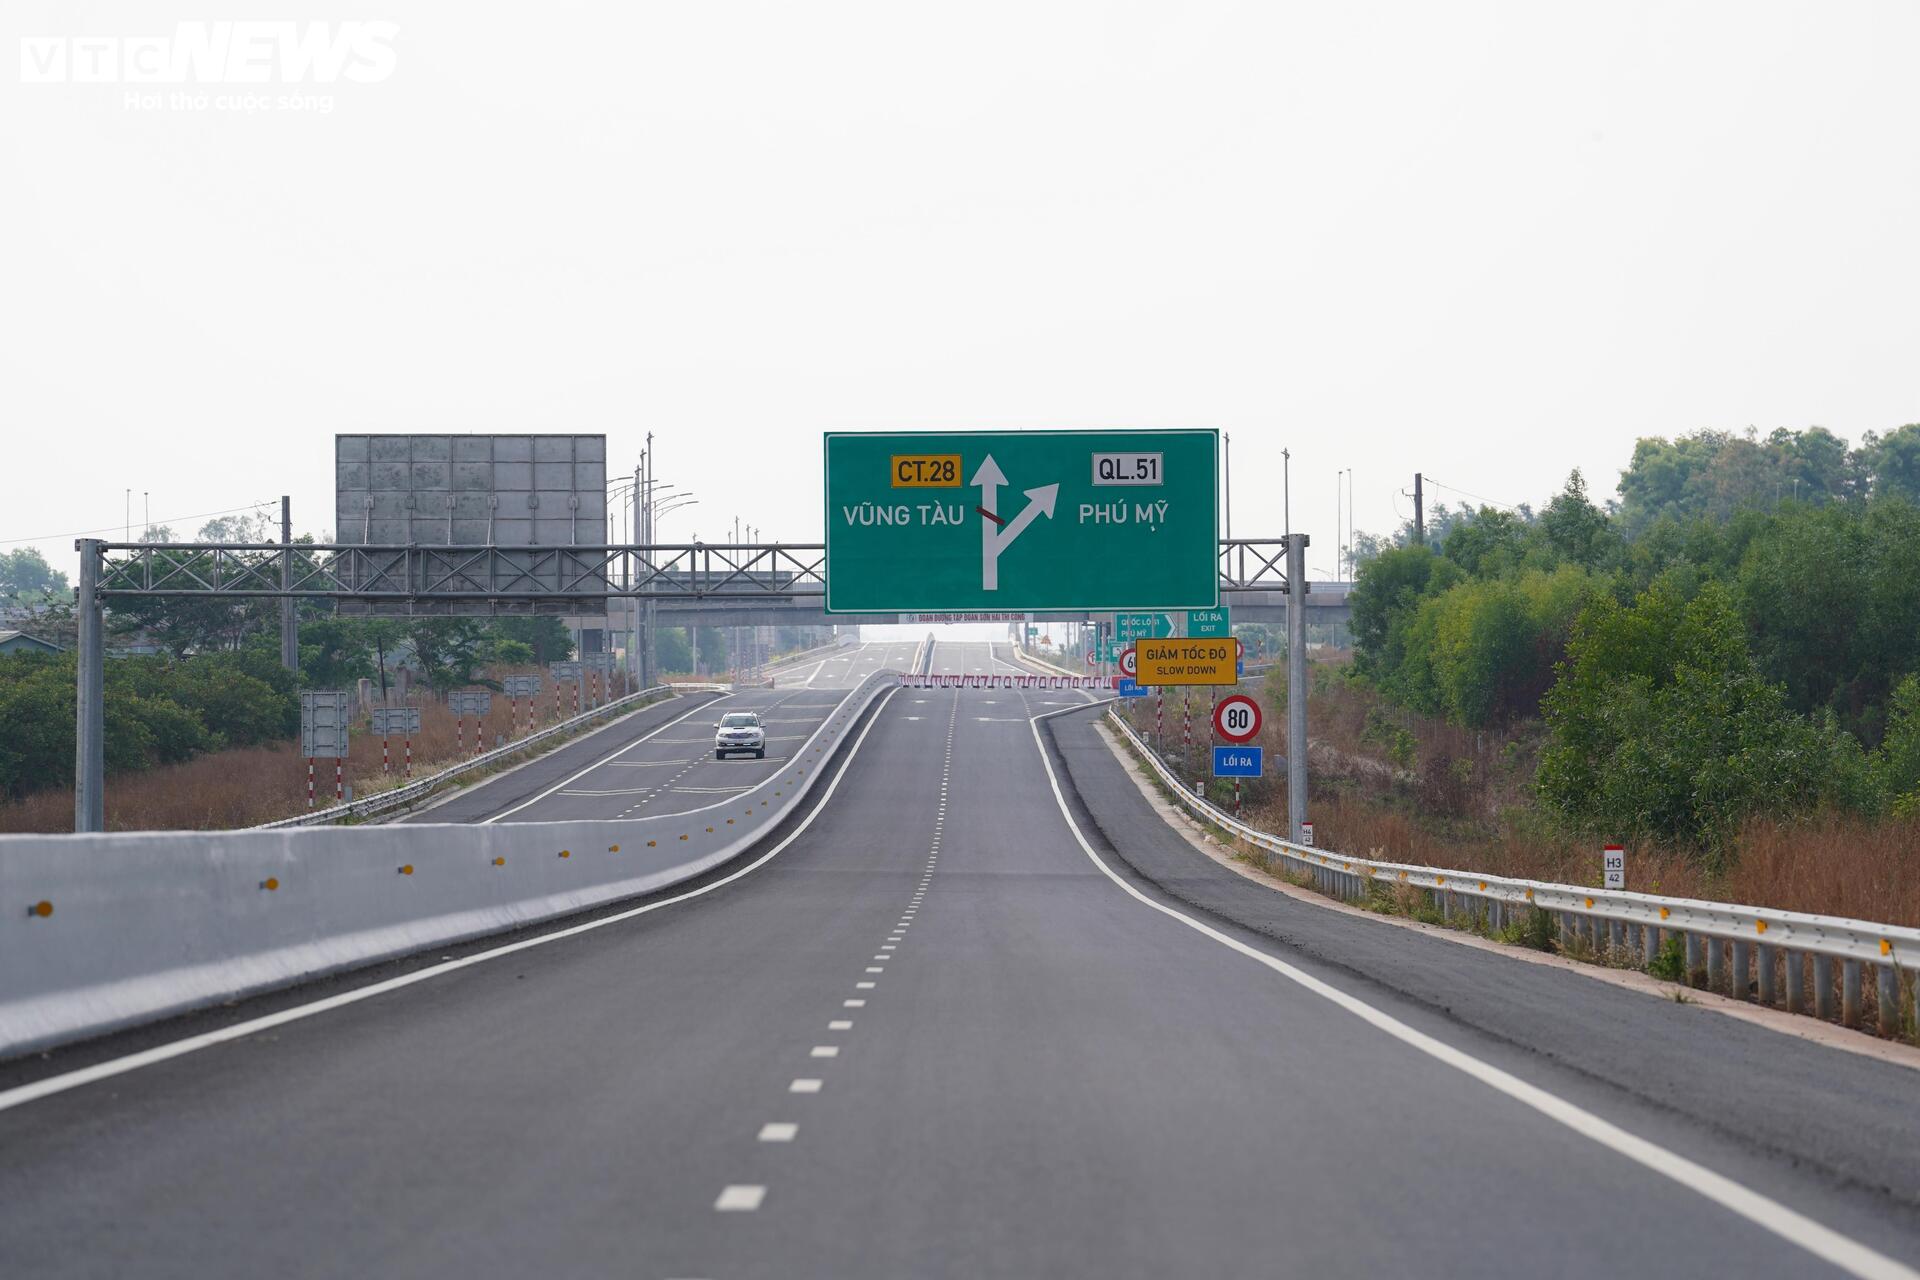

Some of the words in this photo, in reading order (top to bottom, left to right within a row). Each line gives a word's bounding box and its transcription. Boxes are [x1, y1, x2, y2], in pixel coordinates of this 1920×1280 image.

[898, 460, 955, 482] CT.28
[1099, 458, 1157, 480] QL.51
[843, 501, 910, 526] VŨNG
[916, 500, 965, 526] TÀU
[1079, 498, 1127, 524] PHÚ
[1135, 499, 1169, 524] MỸ
[1193, 611, 1209, 622] LỐI
[1210, 613, 1223, 622] RA
[1146, 645, 1178, 660] GIẢM
[1182, 645, 1204, 660] TỐC
[1209, 647, 1227, 661] ĐỘ
[1156, 666, 1184, 675] SLOW
[1187, 666, 1216, 675] DOWN
[1228, 708, 1248, 729] 80
[1223, 753, 1238, 767] LỐI
[1240, 757, 1252, 767] RA
[1607, 858, 1622, 868] H3
[1609, 874, 1620, 882] 42
